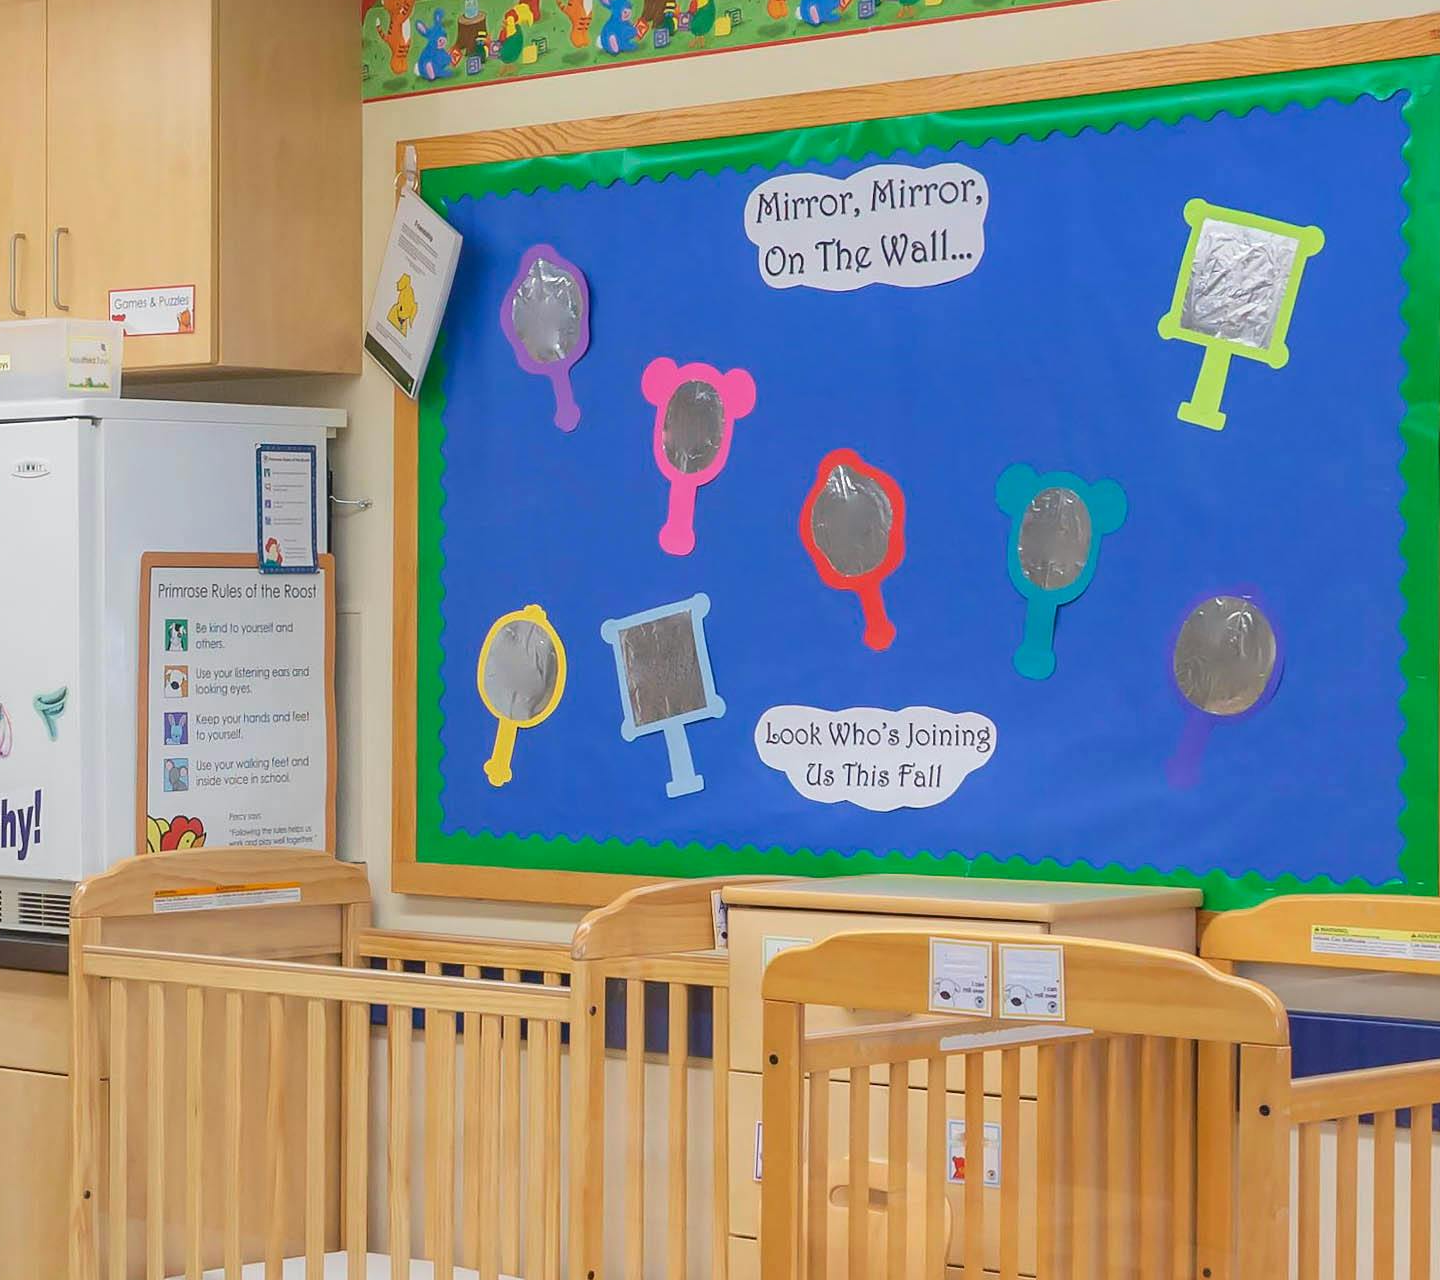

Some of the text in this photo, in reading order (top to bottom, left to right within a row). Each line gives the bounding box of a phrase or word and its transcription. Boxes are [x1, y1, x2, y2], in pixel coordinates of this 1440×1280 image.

[756, 178, 983, 224] Mirror, Mirror,
[765, 228, 972, 276] On The Wall...
[114, 294, 189, 310] Games & Puzzles
[158, 583, 317, 599] Primrose Rules of the Roost
[195, 622, 294, 636] Be kind to yourself and
[195, 666, 310, 681] Use your listening ears and
[195, 683, 228, 696] looking
[195, 711, 310, 726] Keep your hands and feet
[195, 729, 206, 740] to
[765, 721, 991, 753] Look Who's Joining
[195, 756, 310, 771] Use your walking feet and
[195, 774, 222, 786] inside
[224, 774, 249, 786] voice
[250, 774, 260, 784] in
[806, 762, 943, 788] Us This Fall
[262, 827, 272, 835] the
[272, 826, 287, 834] rules
[287, 825, 304, 834] helps
[305, 825, 312, 833] us
[244, 838, 258, 846] and
[273, 836, 286, 844] well
